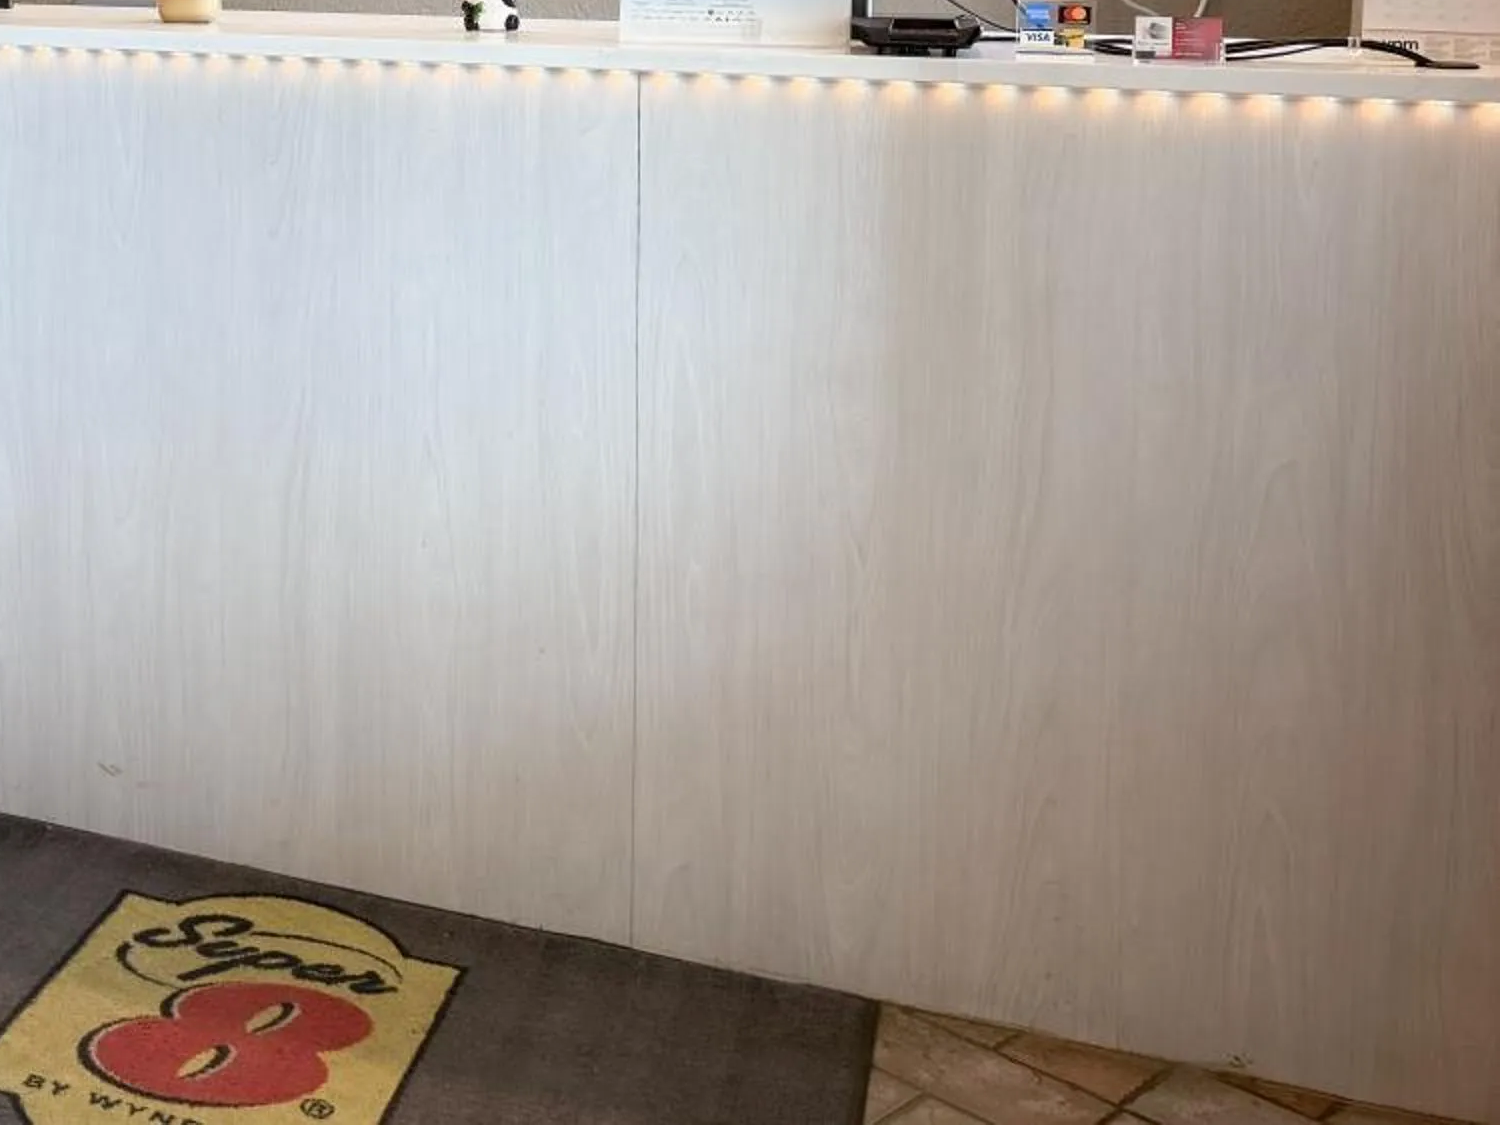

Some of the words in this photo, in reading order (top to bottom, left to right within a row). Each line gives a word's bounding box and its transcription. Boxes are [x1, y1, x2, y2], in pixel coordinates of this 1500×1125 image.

[1025, 33, 1051, 42] VISA
[133, 914, 398, 994] Super
[77, 980, 374, 1108] 8
[23, 1074, 71, 1096] BY
